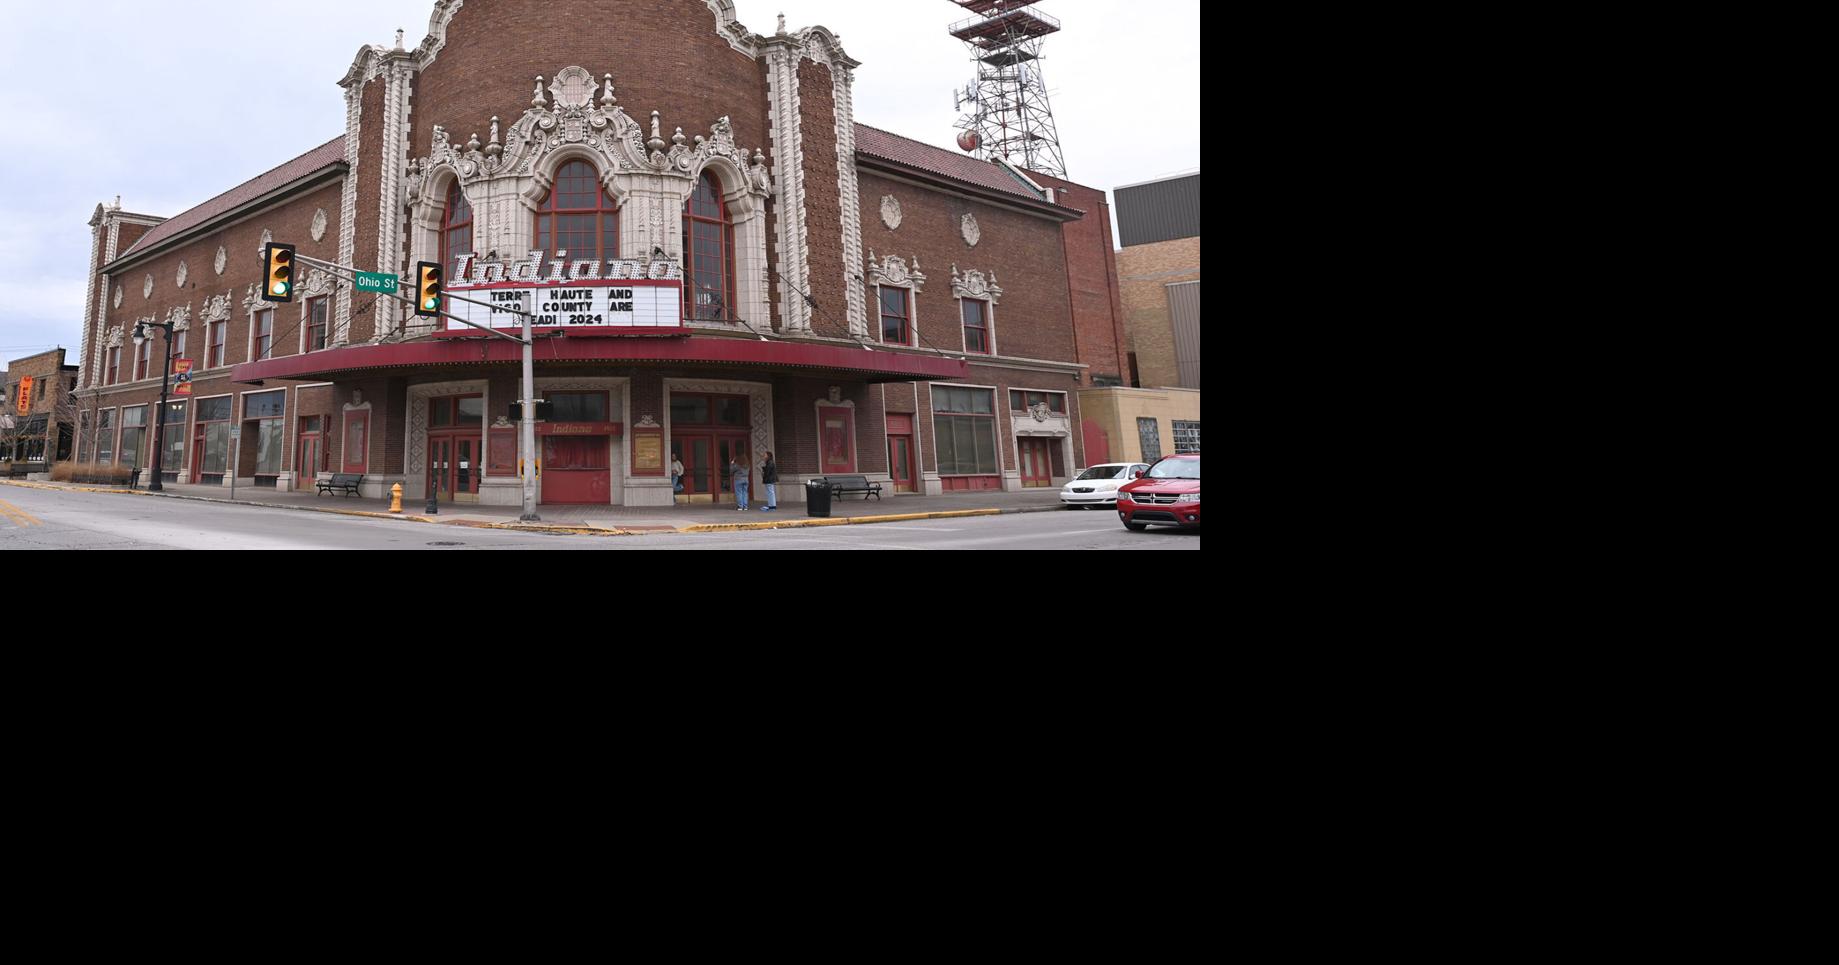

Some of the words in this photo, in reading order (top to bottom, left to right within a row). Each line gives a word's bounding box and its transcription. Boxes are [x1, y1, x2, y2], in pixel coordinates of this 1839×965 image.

[447, 248, 680, 287] Indiana
[358, 276, 380, 287] Ohio
[384, 278, 395, 288] St
[491, 290, 530, 301] TERR
[550, 289, 593, 300] HAUTE
[608, 289, 632, 299] AND
[543, 302, 592, 312] COUNTY
[610, 302, 632, 312] ARE
[530, 315, 556, 325] EADI
[569, 315, 602, 325] 2024
[552, 423, 593, 433] Indiana
